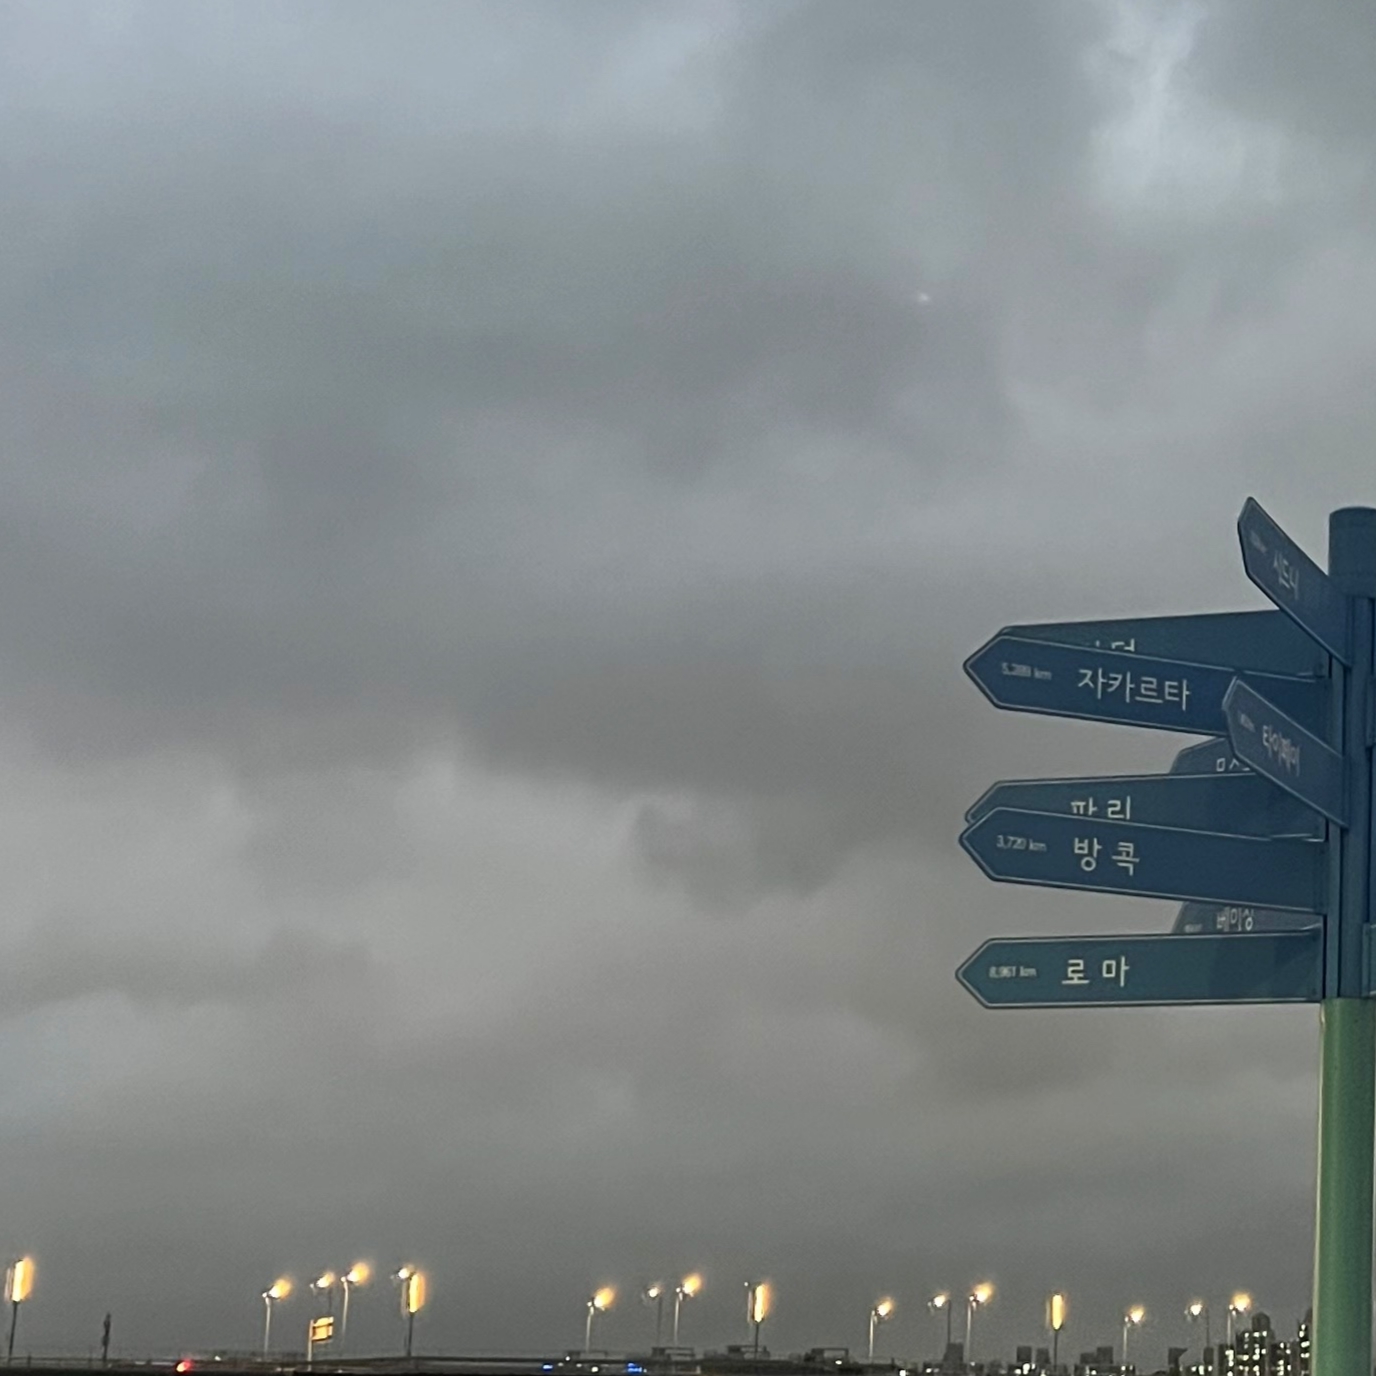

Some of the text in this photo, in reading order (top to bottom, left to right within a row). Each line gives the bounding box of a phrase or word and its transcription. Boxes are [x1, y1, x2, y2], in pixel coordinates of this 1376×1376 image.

[1077, 667, 1191, 712] 자카르타
[1073, 837, 1140, 877] 방콕
[1061, 955, 1132, 988] 로마
